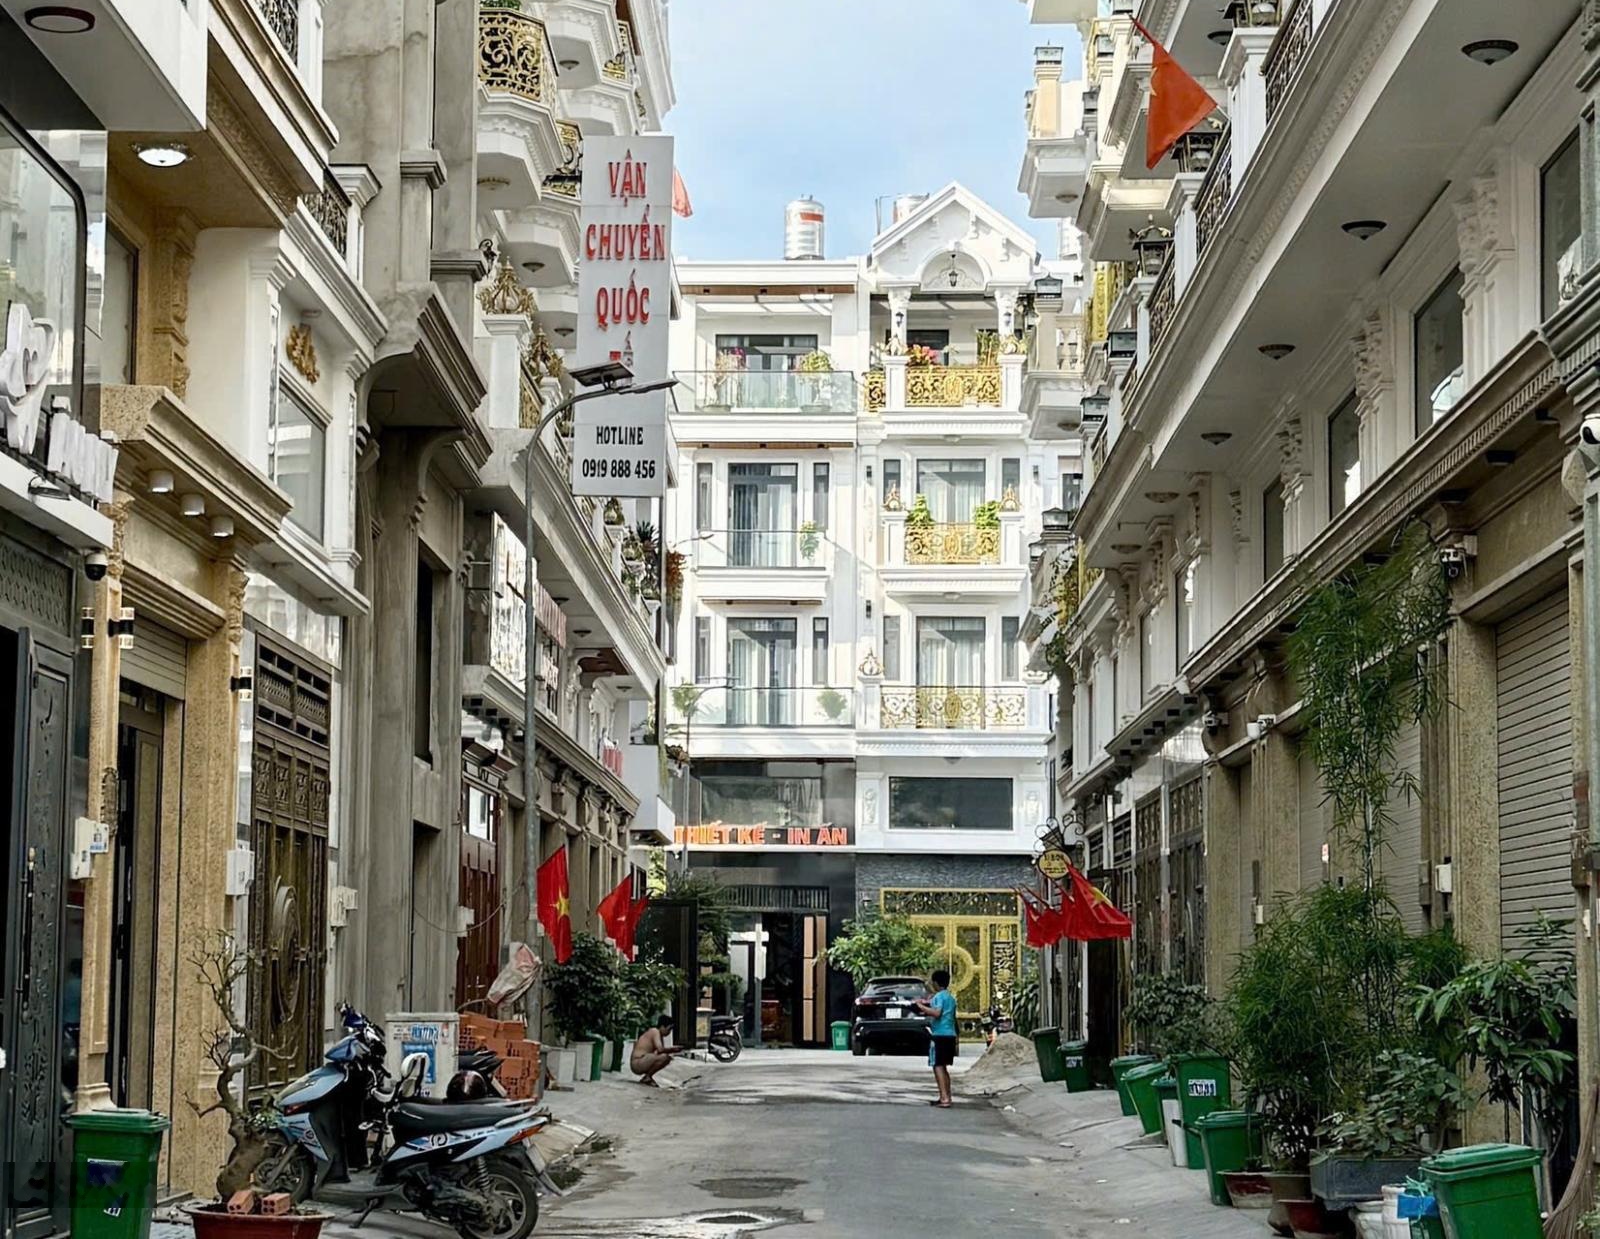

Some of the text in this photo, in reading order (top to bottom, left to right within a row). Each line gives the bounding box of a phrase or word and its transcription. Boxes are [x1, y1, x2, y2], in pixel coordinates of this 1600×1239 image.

[608, 148, 648, 207] VẬN
[596, 267, 651, 332] QUỐC
[596, 425, 644, 446] HOTLINE
[582, 458, 656, 480] 0919 888 456
[787, 827, 811, 846] IN
